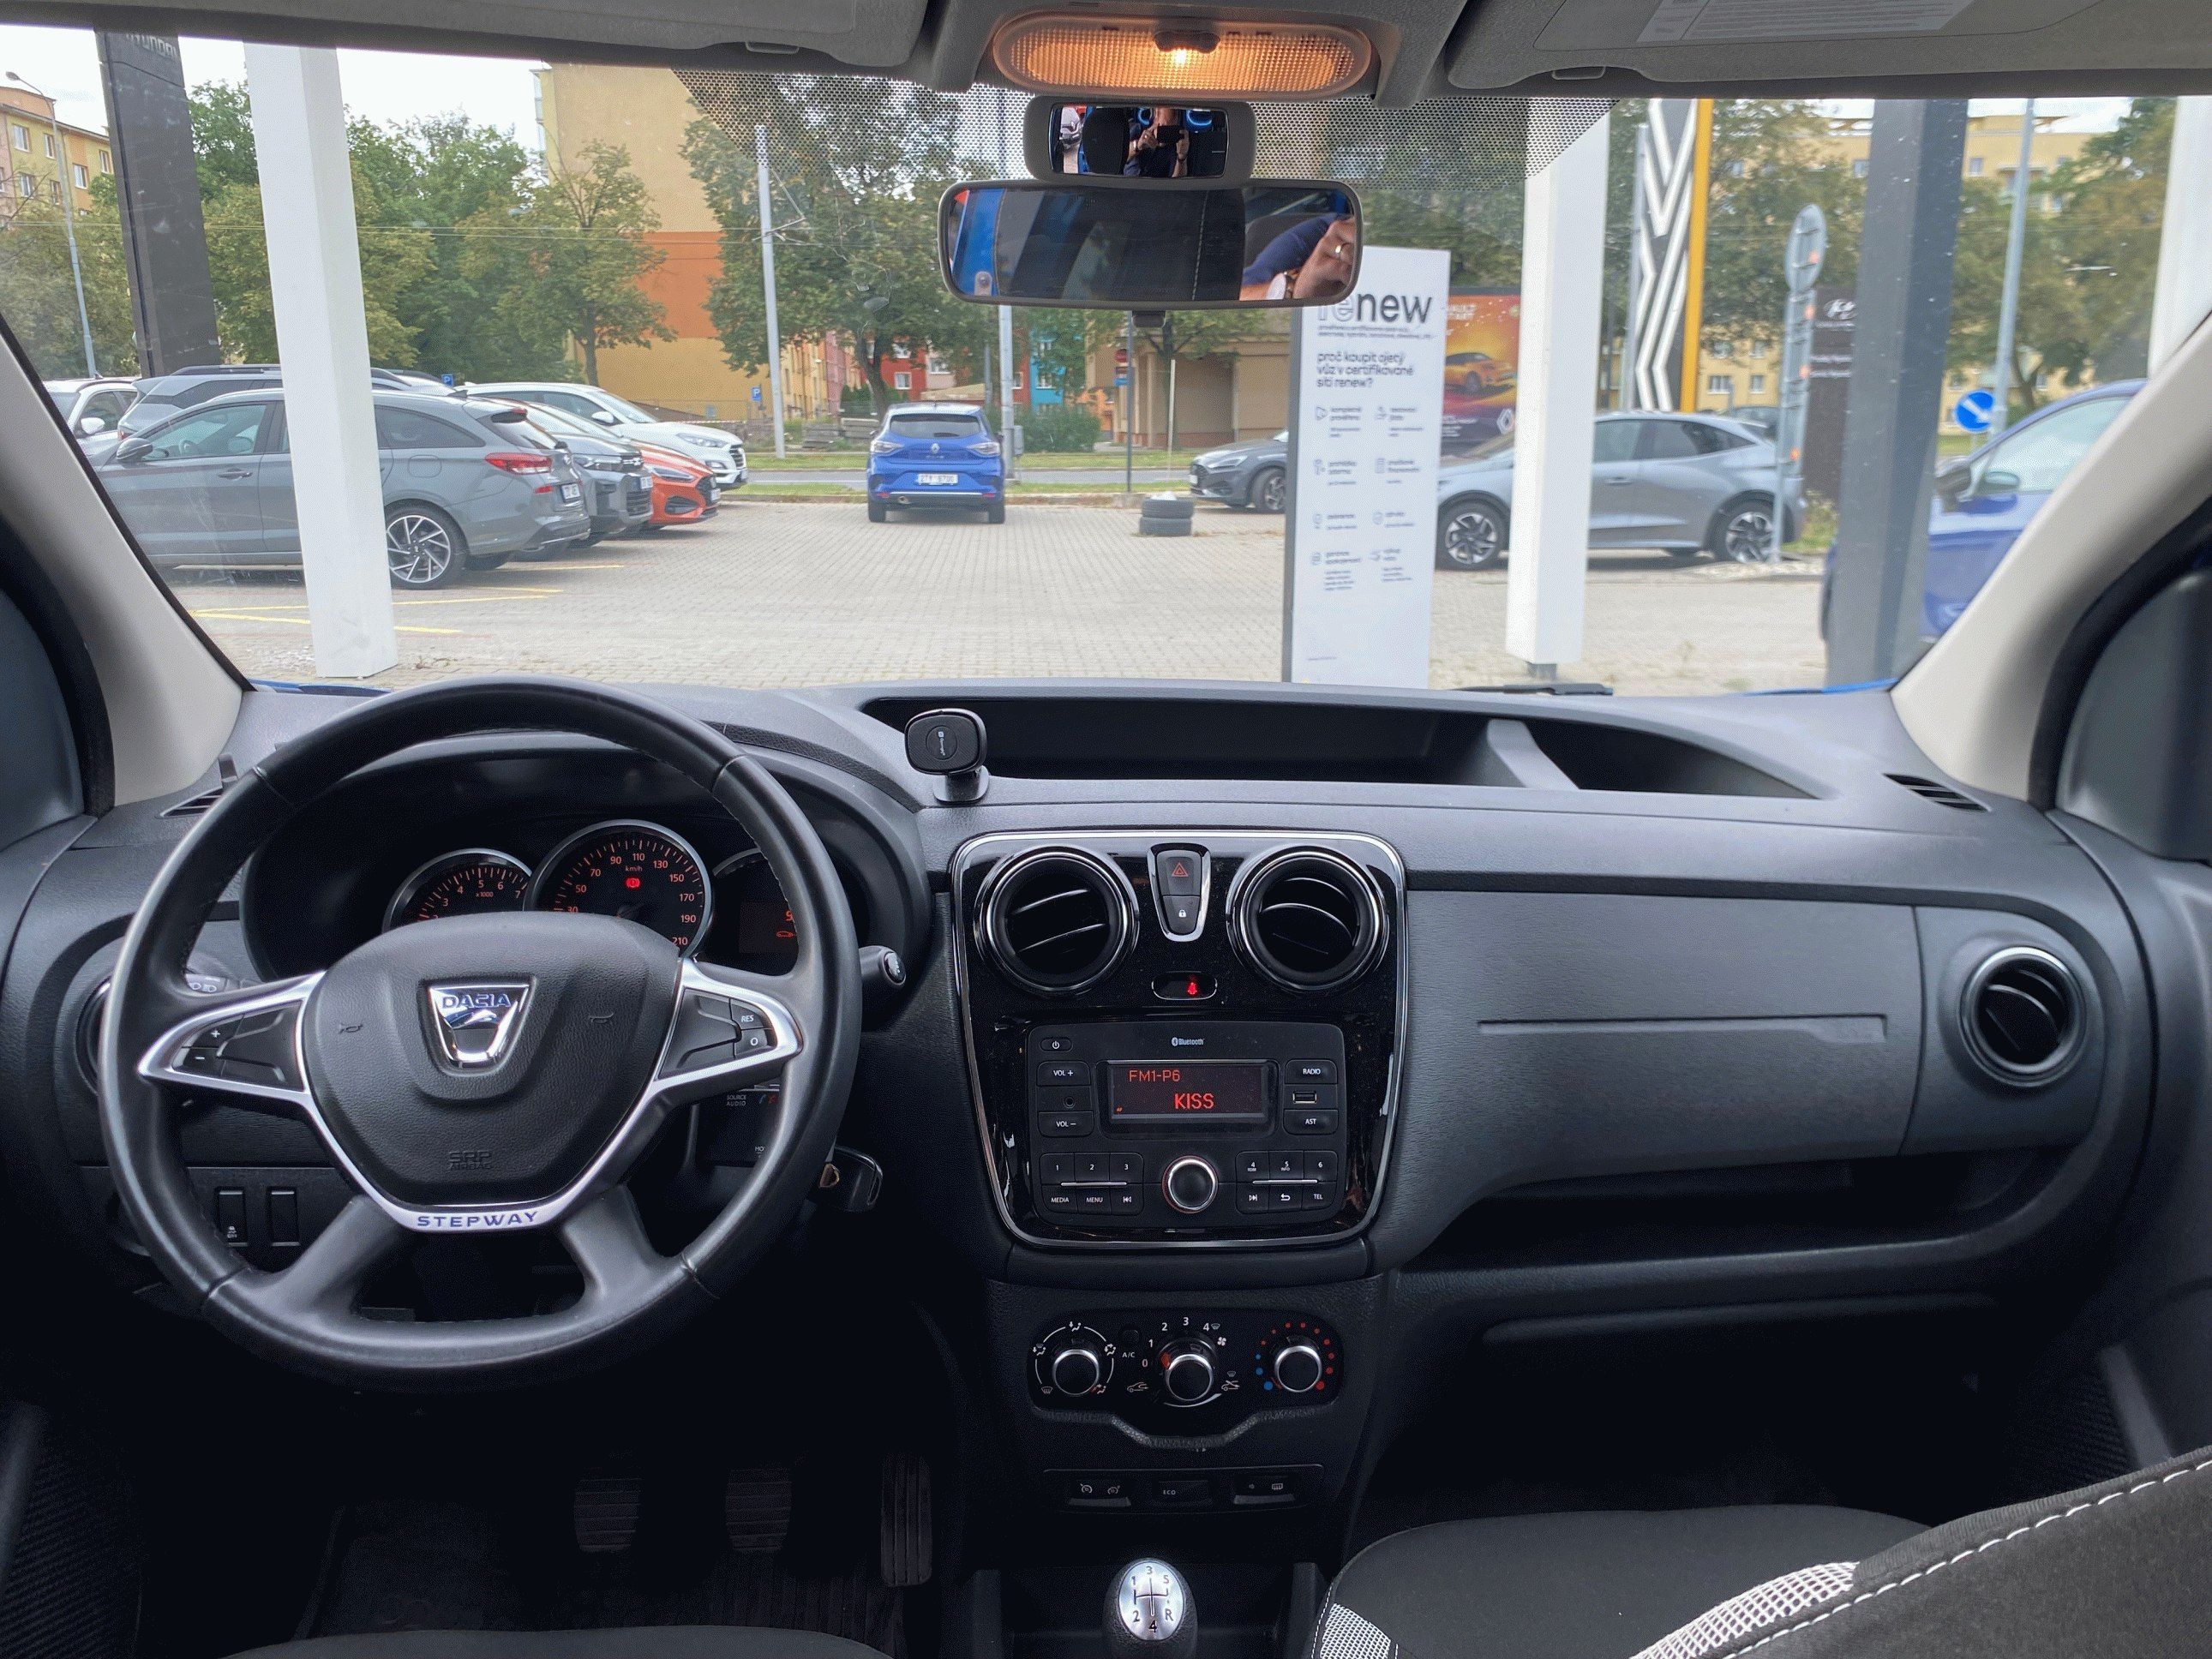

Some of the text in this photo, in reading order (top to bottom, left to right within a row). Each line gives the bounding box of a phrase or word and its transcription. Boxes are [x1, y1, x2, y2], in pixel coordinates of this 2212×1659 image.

[632, 853, 644, 861] 110
[653, 860, 668, 869] 130
[590, 868, 601, 877] 70
[669, 874, 684, 883] 150
[575, 884, 587, 893] 50
[680, 914, 697, 923] 190
[442, 993, 512, 1009] DACIA
[1129, 1070, 1180, 1082] FM1-P6
[1175, 1093, 1214, 1110] KISS
[417, 1211, 538, 1227] STEPWAY
[1183, 1317, 1189, 1326] 3
[1161, 1322, 1168, 1332] 2
[1202, 1323, 1210, 1332] 4
[1148, 1339, 1154, 1348] 1
[1146, 1566, 1153, 1574] 3
[1131, 1576, 1136, 1585] 1
[1163, 1575, 1170, 1584] 5
[1133, 1610, 1140, 1622] 2
[1165, 1608, 1174, 1621] R
[1148, 1620, 1158, 1633] 4
